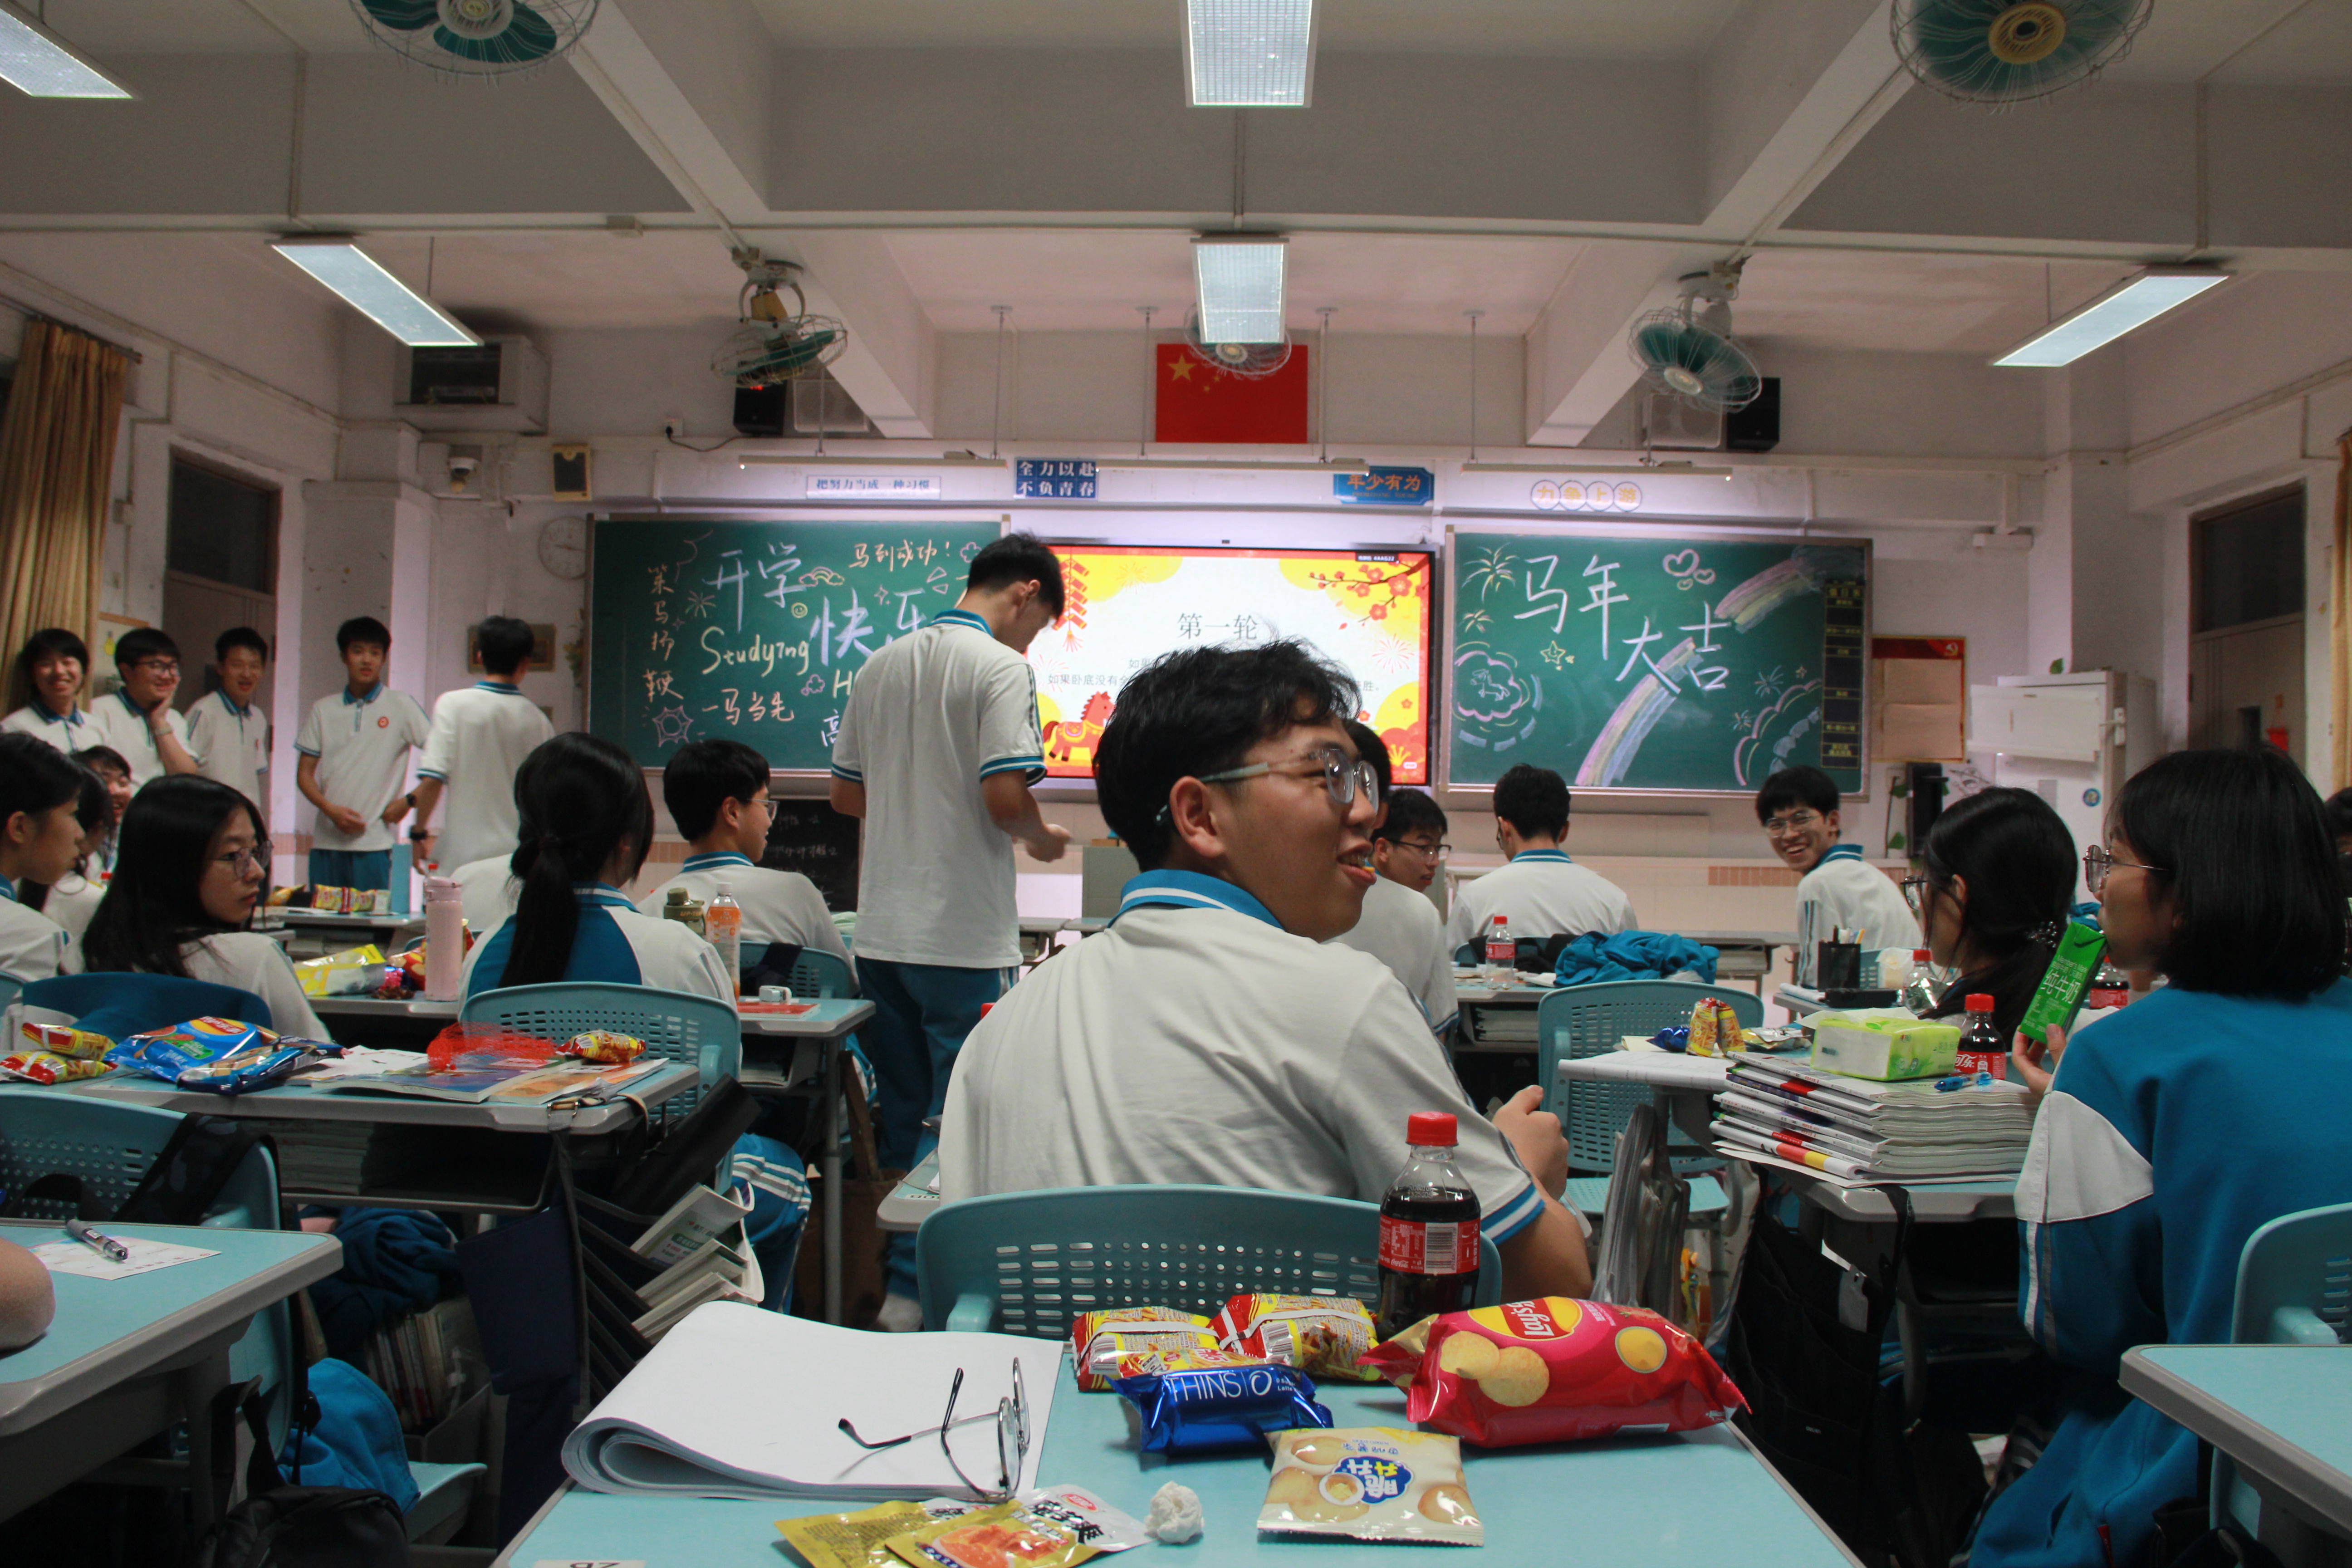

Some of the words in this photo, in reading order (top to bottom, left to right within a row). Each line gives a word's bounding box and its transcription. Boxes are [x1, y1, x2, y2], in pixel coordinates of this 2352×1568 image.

[1019, 461, 1094, 477] 全力以赴
[1347, 474, 1421, 491] 年少有为
[1018, 481, 1094, 496] 不负青春
[1537, 486, 1637, 504] 力争上游
[1177, 612, 1259, 641] 第一轮
[701, 626, 809, 677] Studying
[702, 689, 794, 725] 一马当先
[2040, 969, 2082, 1004] 纯牛奶
[1511, 1307, 1555, 1337] Lay's
[1166, 1372, 1241, 1402] THINS
